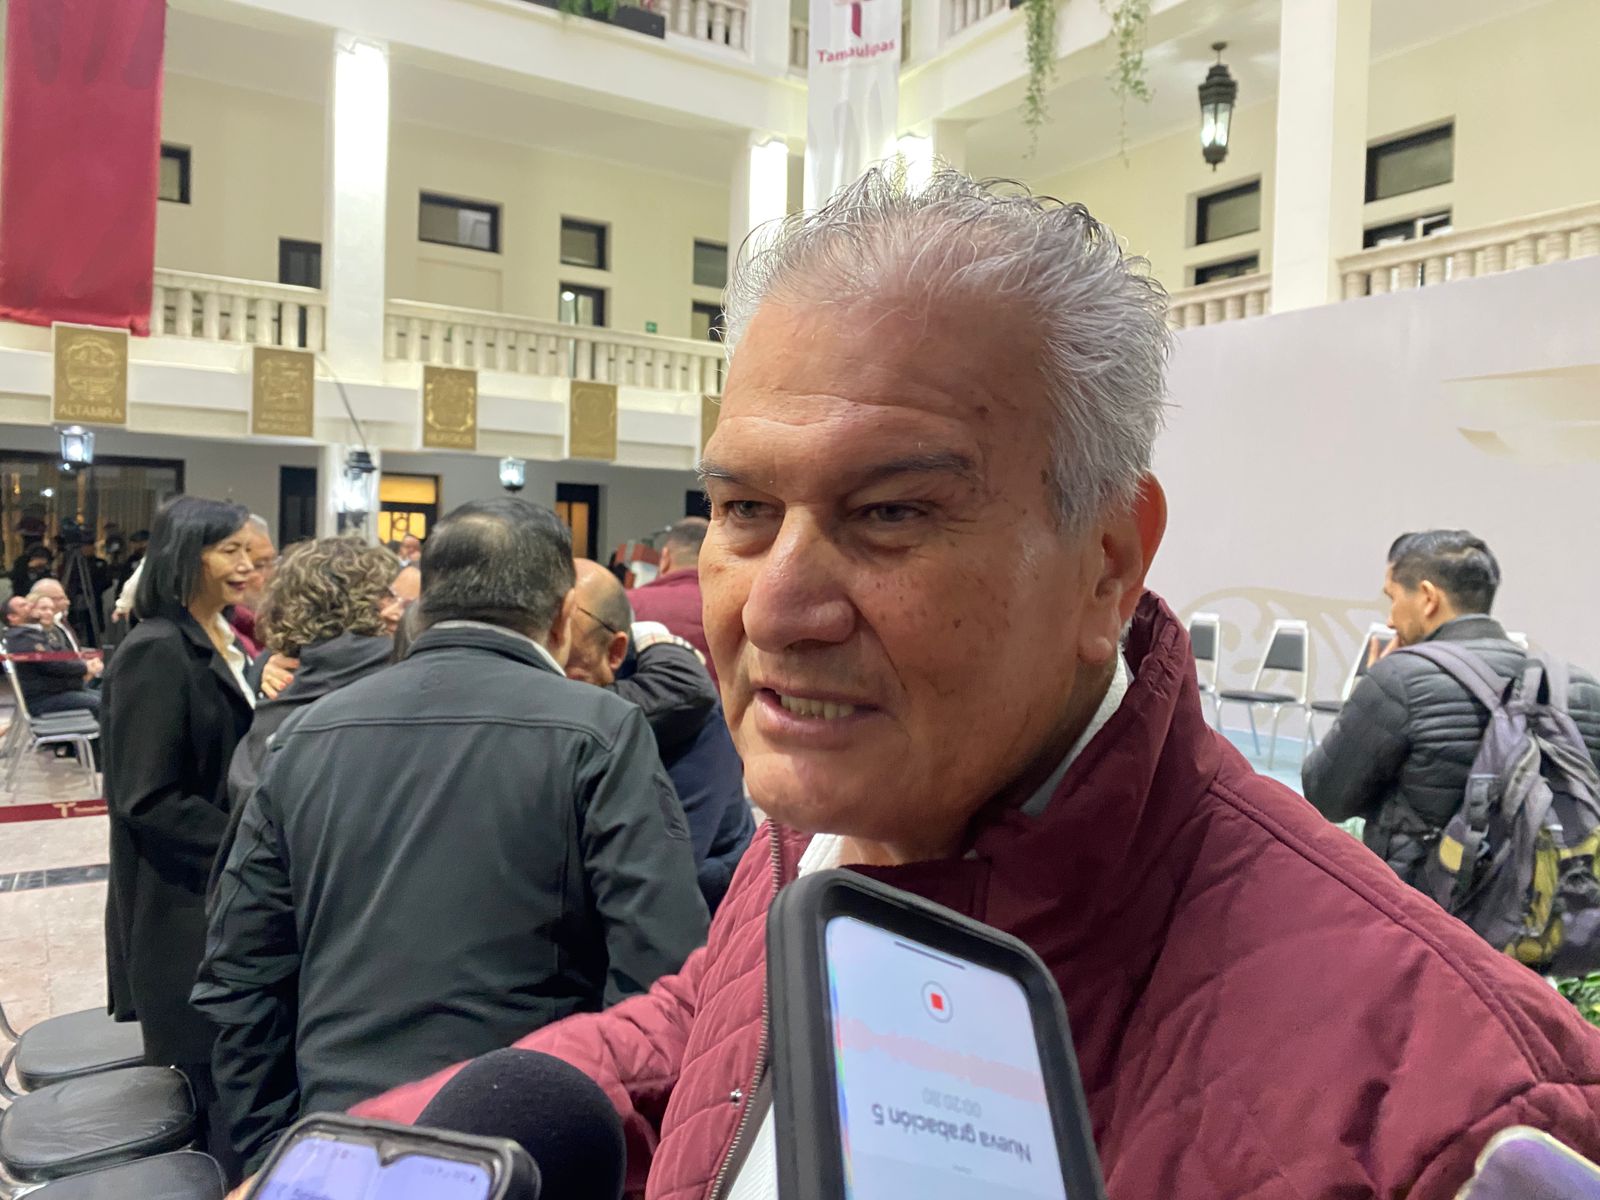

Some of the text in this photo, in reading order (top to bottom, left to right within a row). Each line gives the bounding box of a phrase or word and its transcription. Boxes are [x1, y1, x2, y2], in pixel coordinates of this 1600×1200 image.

[816, 39, 896, 63] Tamaulipas
[59, 403, 123, 419] ALTAMIRA
[871, 1102, 1033, 1164] Nueva grabación 5
